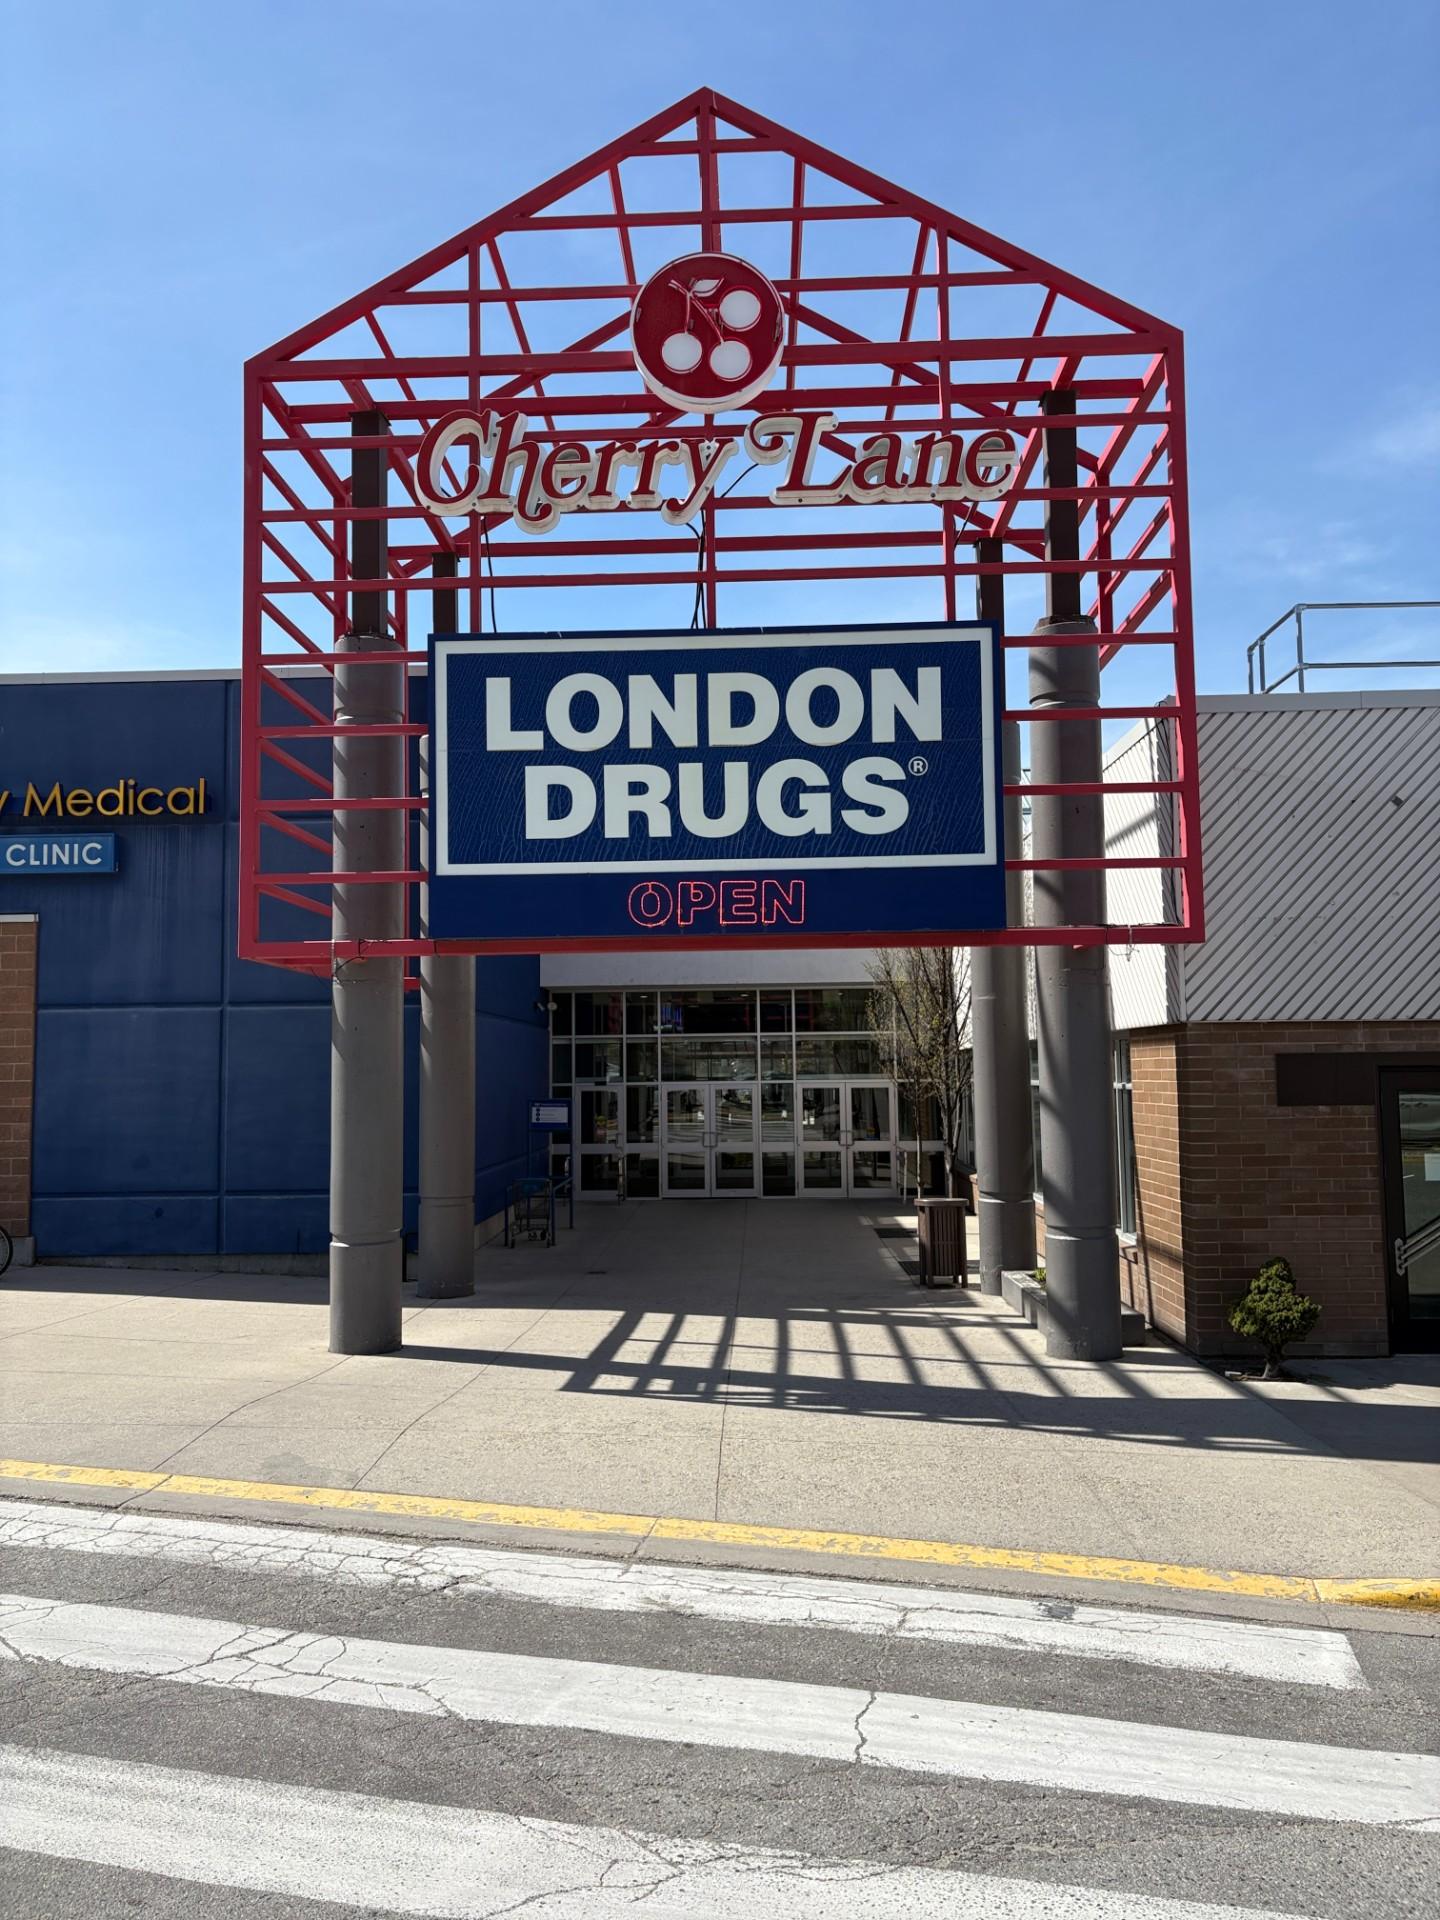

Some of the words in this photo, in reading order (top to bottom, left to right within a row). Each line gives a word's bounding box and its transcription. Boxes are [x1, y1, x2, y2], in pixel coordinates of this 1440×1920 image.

[415, 408, 737, 532] Cherry
[744, 411, 1018, 504] Lane
[485, 666, 943, 751] LONDON
[23, 777, 206, 817] Medical
[6, 843, 103, 867] CLINIC
[628, 880, 805, 928] OPEN
